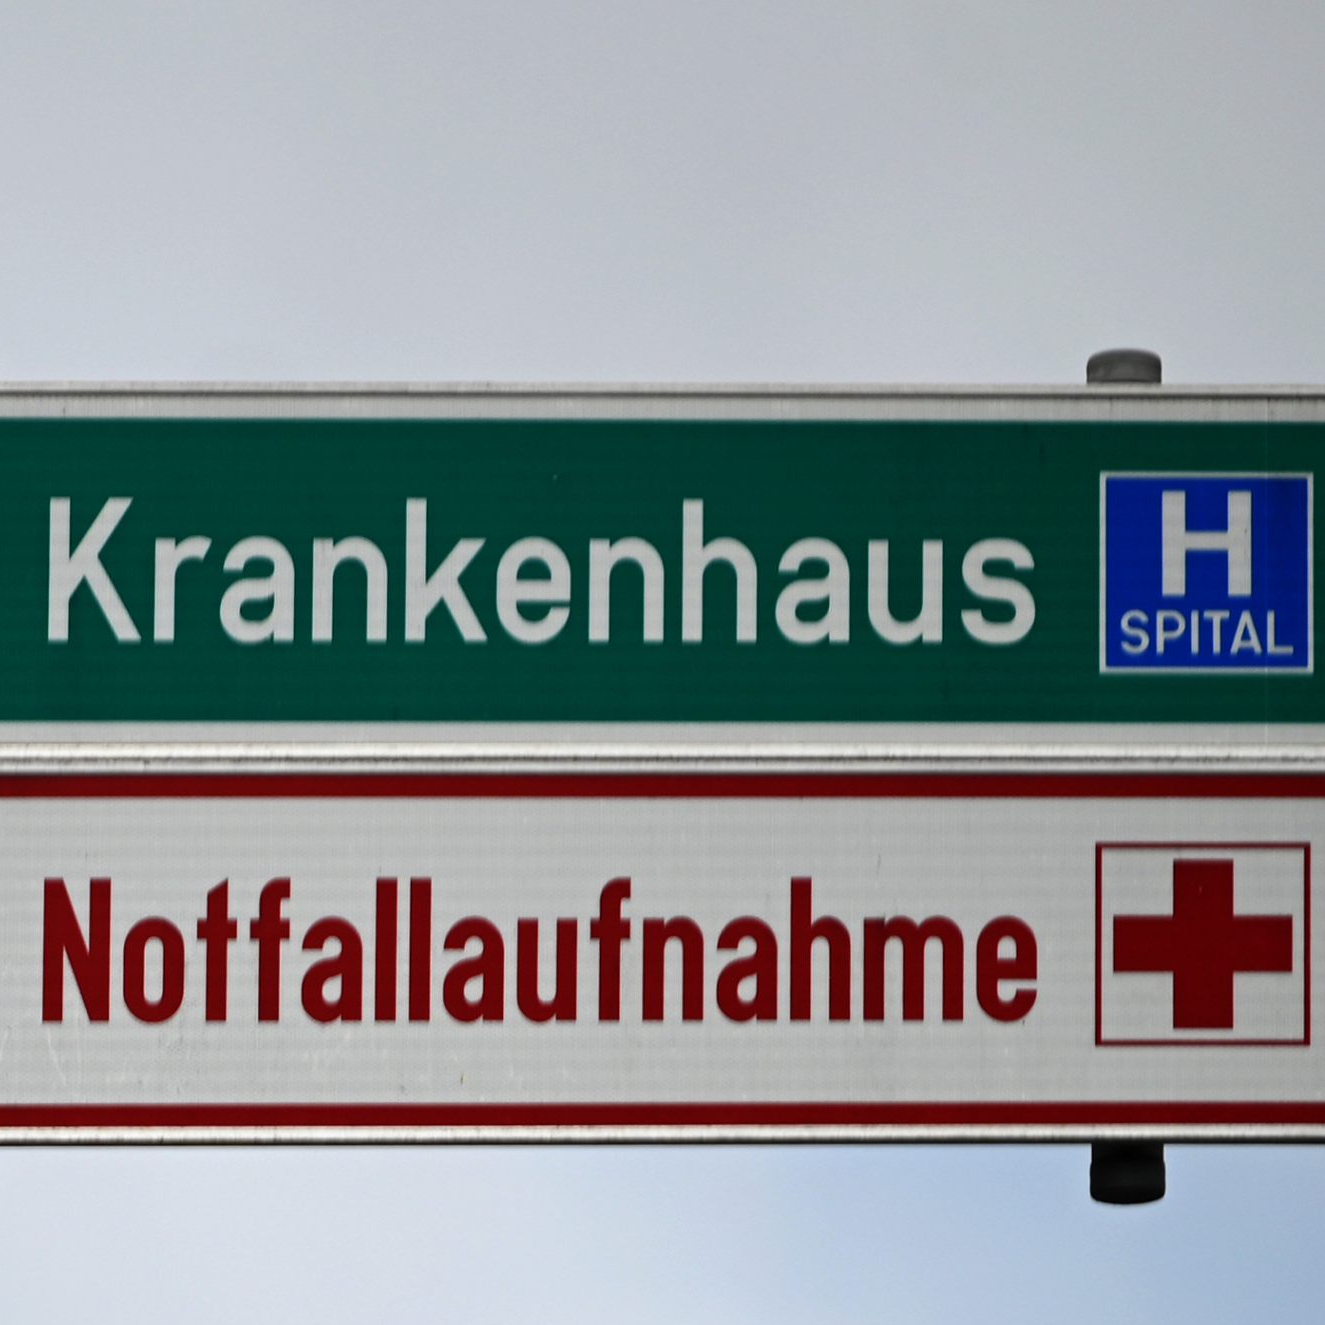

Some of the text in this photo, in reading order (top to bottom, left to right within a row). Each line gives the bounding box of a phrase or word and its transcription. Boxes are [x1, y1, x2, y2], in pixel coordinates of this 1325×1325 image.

[47, 496, 1036, 645] Krankenhaus
[1161, 490, 1252, 597] H
[1120, 609, 1294, 655] SPITAL
[41, 877, 1038, 1025] Notfallaufnahme
